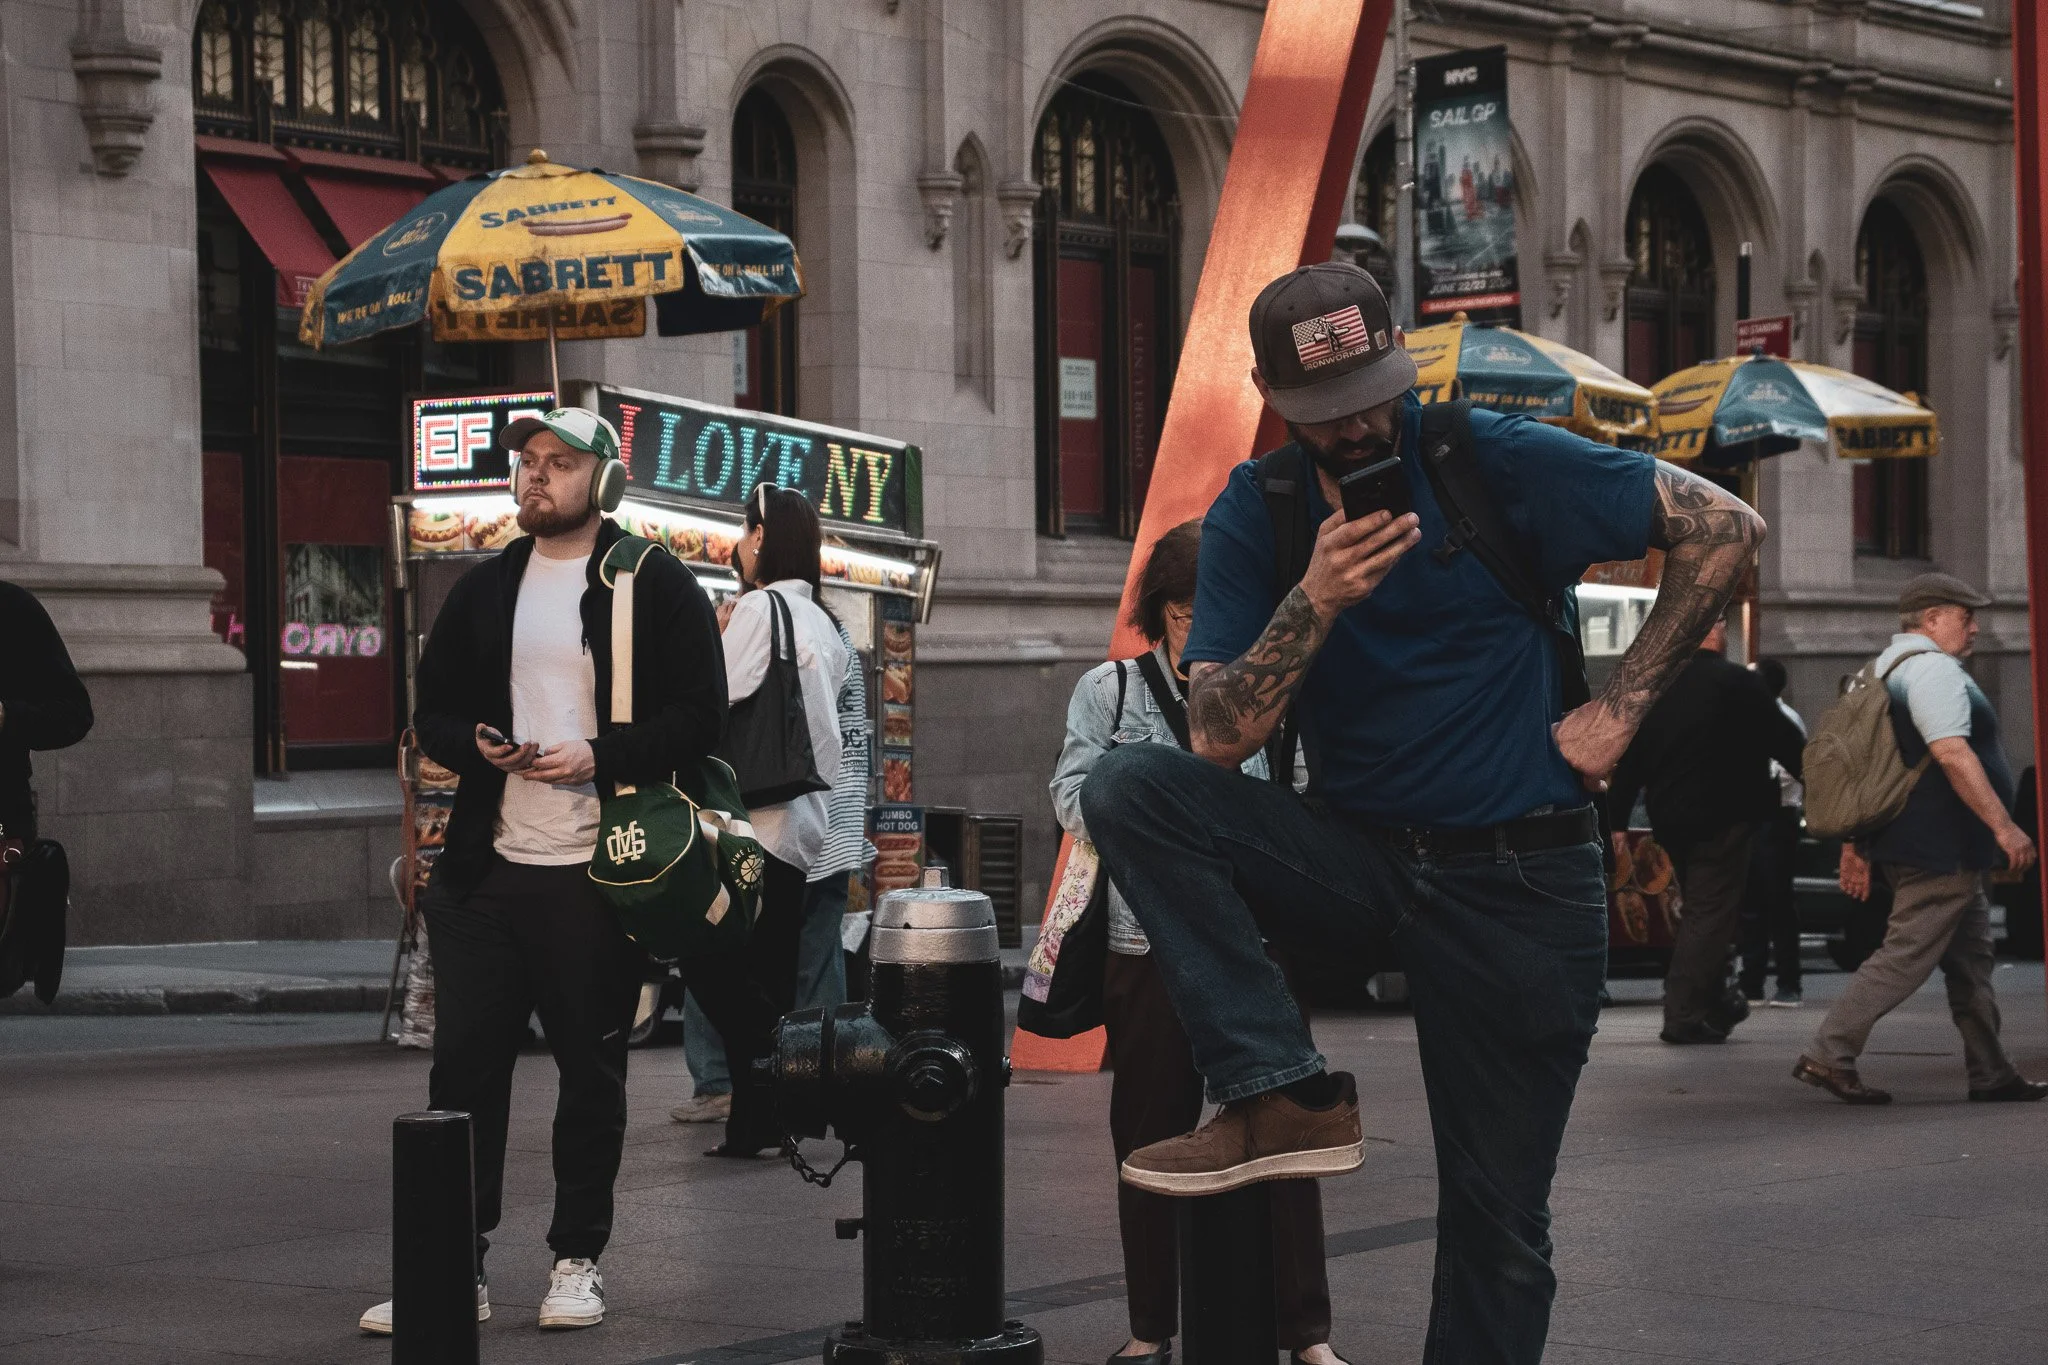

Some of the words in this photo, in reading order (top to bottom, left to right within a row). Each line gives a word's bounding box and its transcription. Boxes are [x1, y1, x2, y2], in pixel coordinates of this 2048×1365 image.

[1444, 66, 1478, 86] NYC
[480, 196, 616, 230] SABRETT
[456, 251, 673, 300] SABRETT
[1304, 344, 1371, 372] IRONWORKERS
[420, 411, 493, 472] EF
[619, 402, 642, 481] I
[653, 410, 811, 500] LOVE
[819, 442, 893, 524] NY
[876, 821, 895, 832] HOT
[897, 820, 919, 832] DOG
[879, 810, 913, 821] JUMBO
